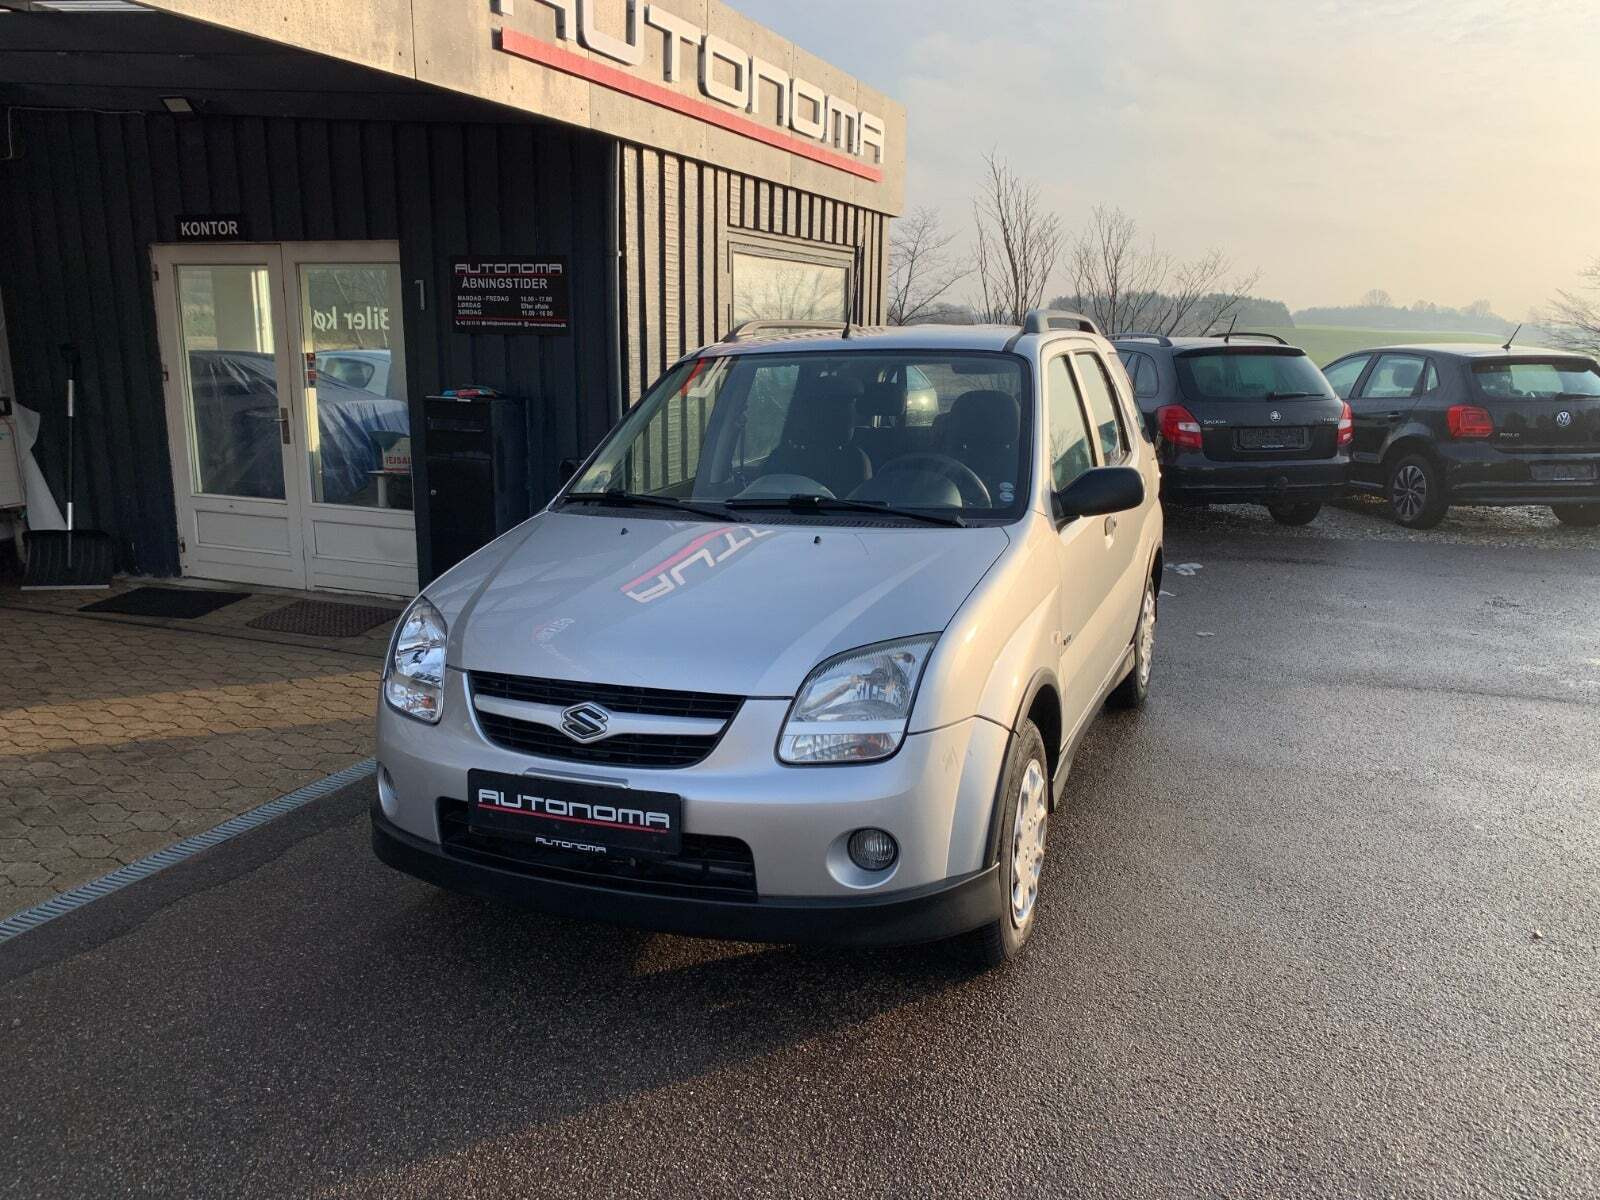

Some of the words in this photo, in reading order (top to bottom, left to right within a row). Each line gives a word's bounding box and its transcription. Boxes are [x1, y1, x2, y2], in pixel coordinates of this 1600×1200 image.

[181, 220, 239, 236] KONTOR
[455, 263, 563, 274] AUTONOMA
[461, 276, 548, 289] ÅBNINGSTIDER
[478, 787, 670, 829] AUTONOMA
[535, 835, 607, 854] AUTONOMA
